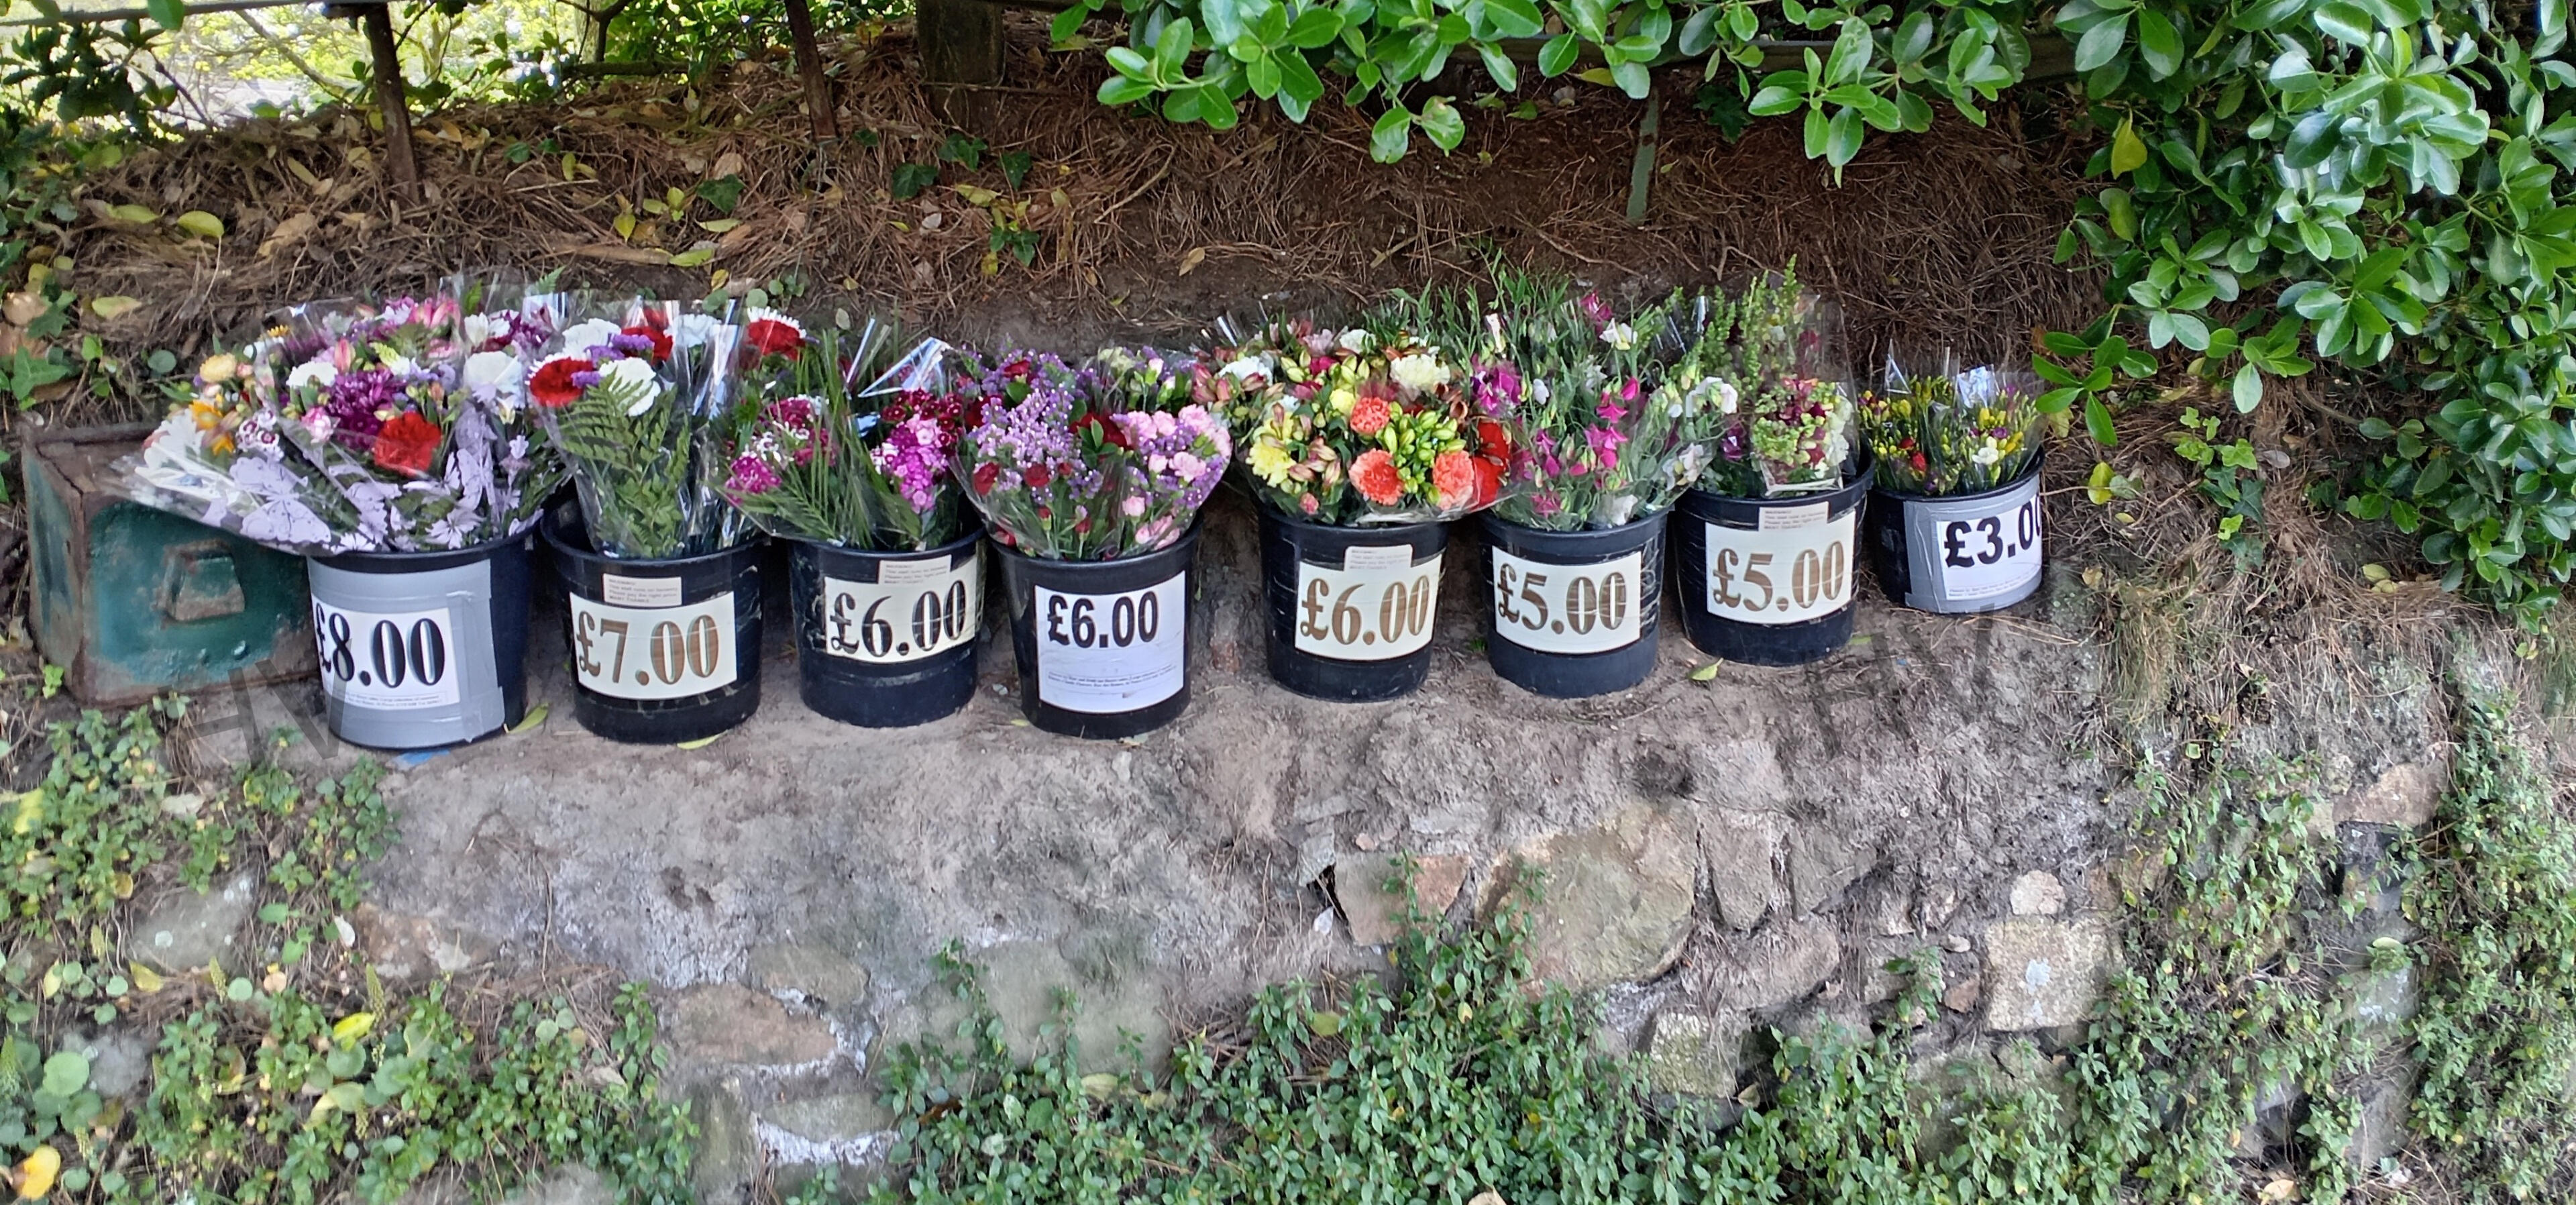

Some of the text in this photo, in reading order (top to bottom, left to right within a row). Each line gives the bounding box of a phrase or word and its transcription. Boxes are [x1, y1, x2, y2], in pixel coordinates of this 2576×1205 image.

[1300, 575, 1430, 645] £6.00
[1498, 563, 1626, 635] £5.00
[1713, 540, 1845, 612] £5.00
[315, 602, 445, 688] £8.00
[576, 611, 719, 685] £7.00
[830, 580, 967, 658] £6.00
[1047, 591, 1159, 648] £6.00
